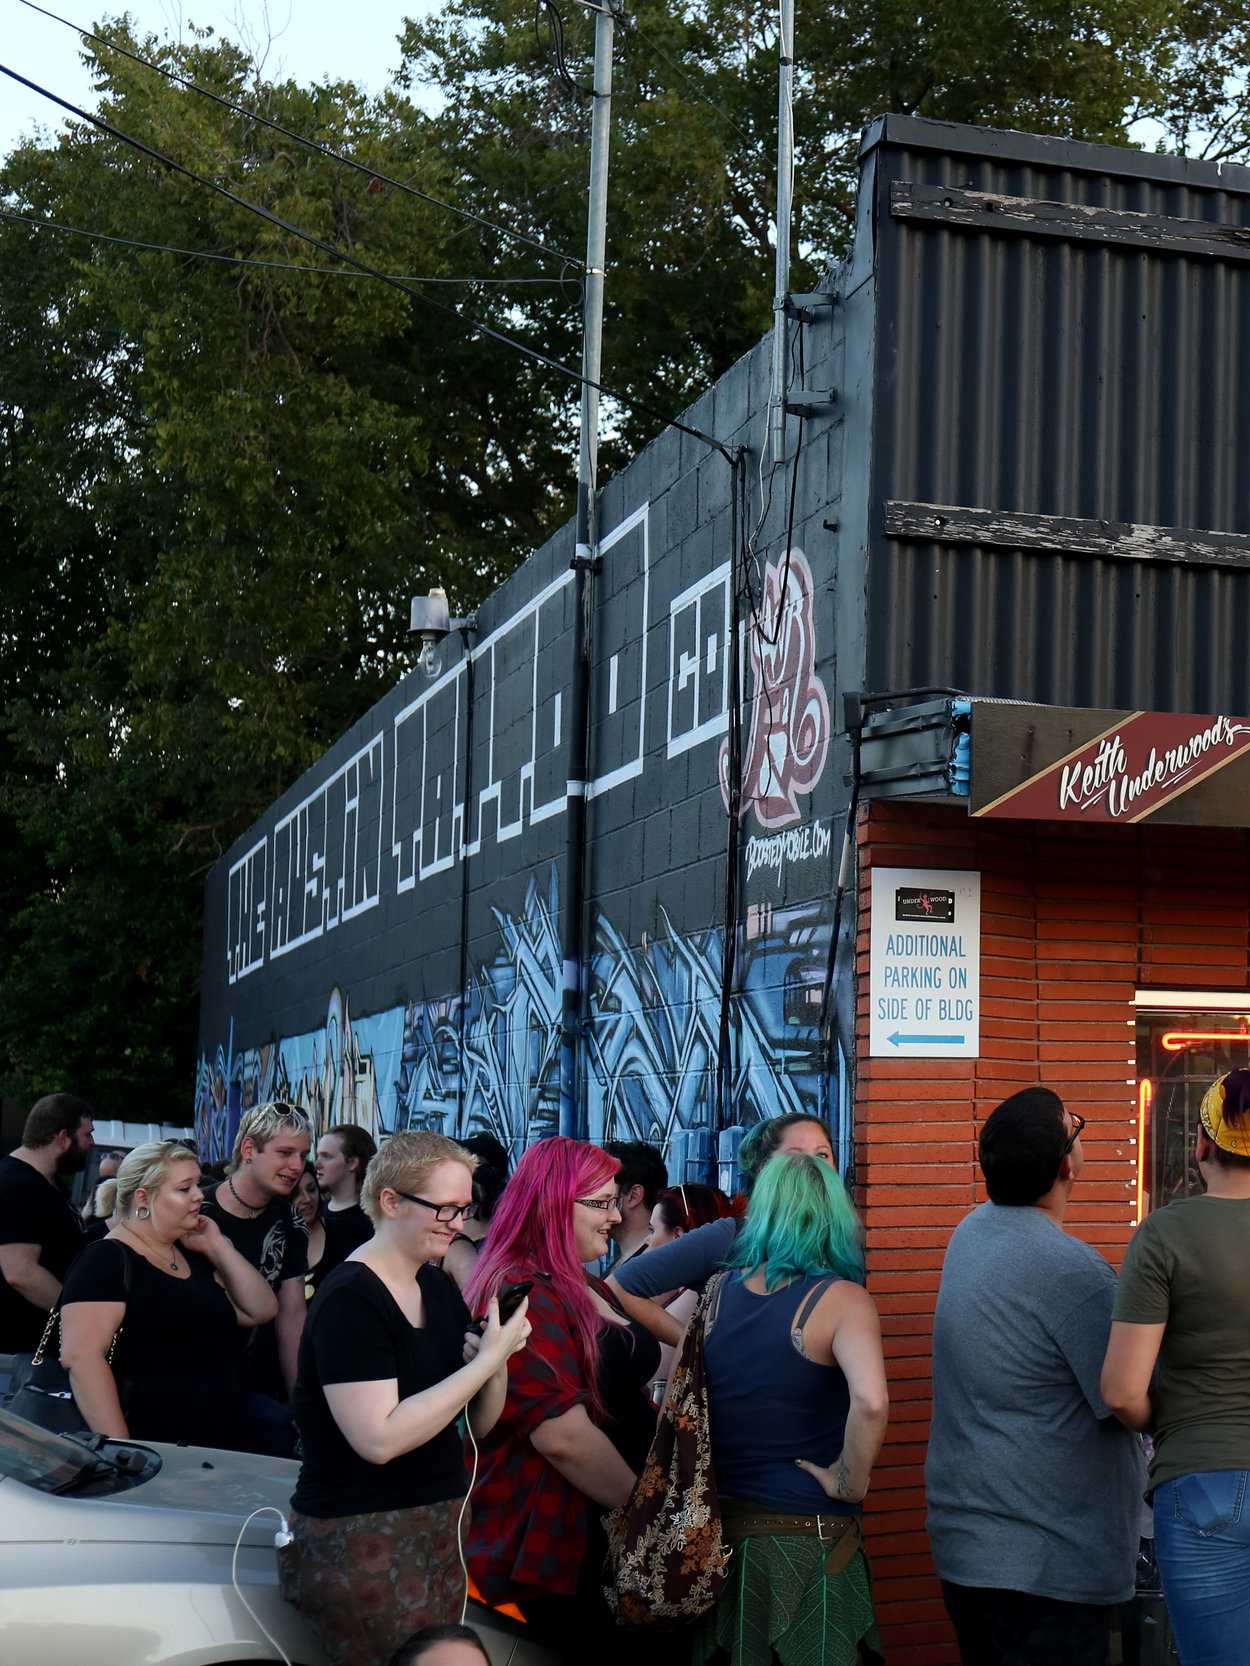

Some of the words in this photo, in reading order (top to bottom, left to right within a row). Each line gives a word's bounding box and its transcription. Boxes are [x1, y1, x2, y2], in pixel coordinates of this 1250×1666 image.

[1060, 735, 1128, 811] Keith
[886, 934, 966, 957] ADDITIONAL
[884, 966, 942, 989] PARKING
[948, 967, 967, 989] ON
[878, 997, 908, 1020] SIDE
[915, 998, 933, 1021] OF
[938, 998, 973, 1021] BLDG
